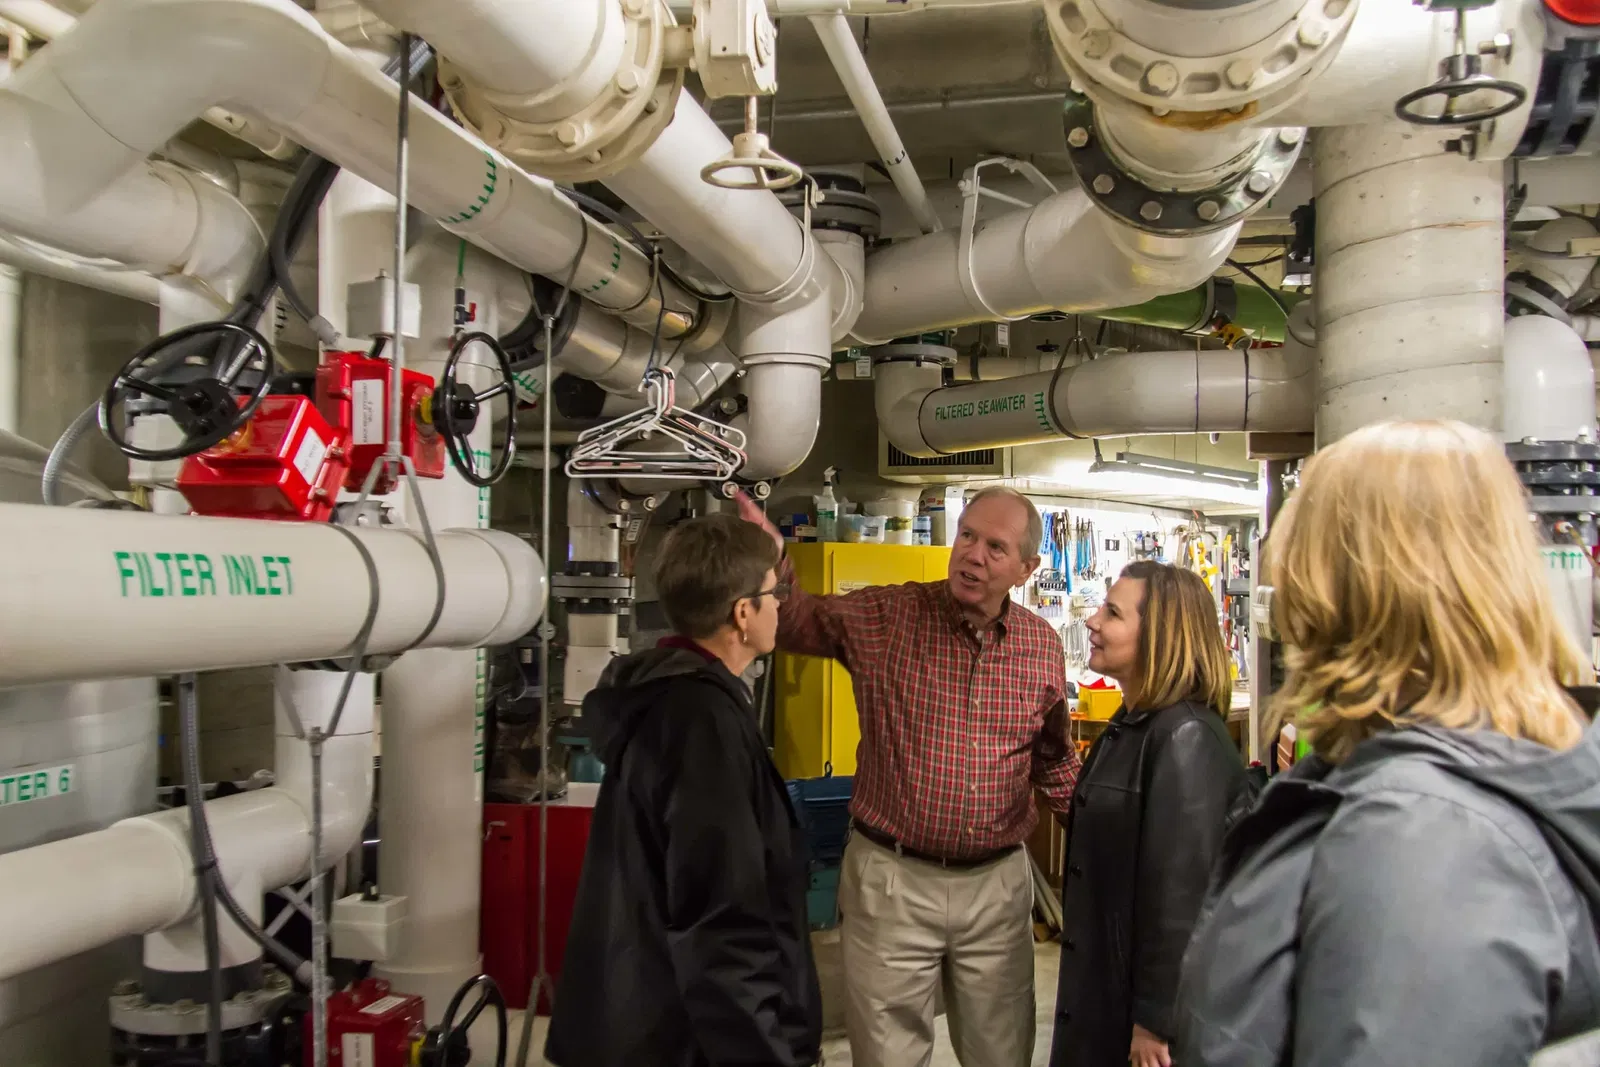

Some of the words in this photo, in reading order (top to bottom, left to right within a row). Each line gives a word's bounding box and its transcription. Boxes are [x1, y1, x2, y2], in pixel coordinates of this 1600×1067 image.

[935, 402, 974, 421] FILTERED
[977, 394, 1026, 416] SEAWATER
[113, 551, 217, 597] FILTER
[221, 553, 293, 596] INLET
[0, 772, 48, 805] TER
[59, 768, 70, 792] 6
